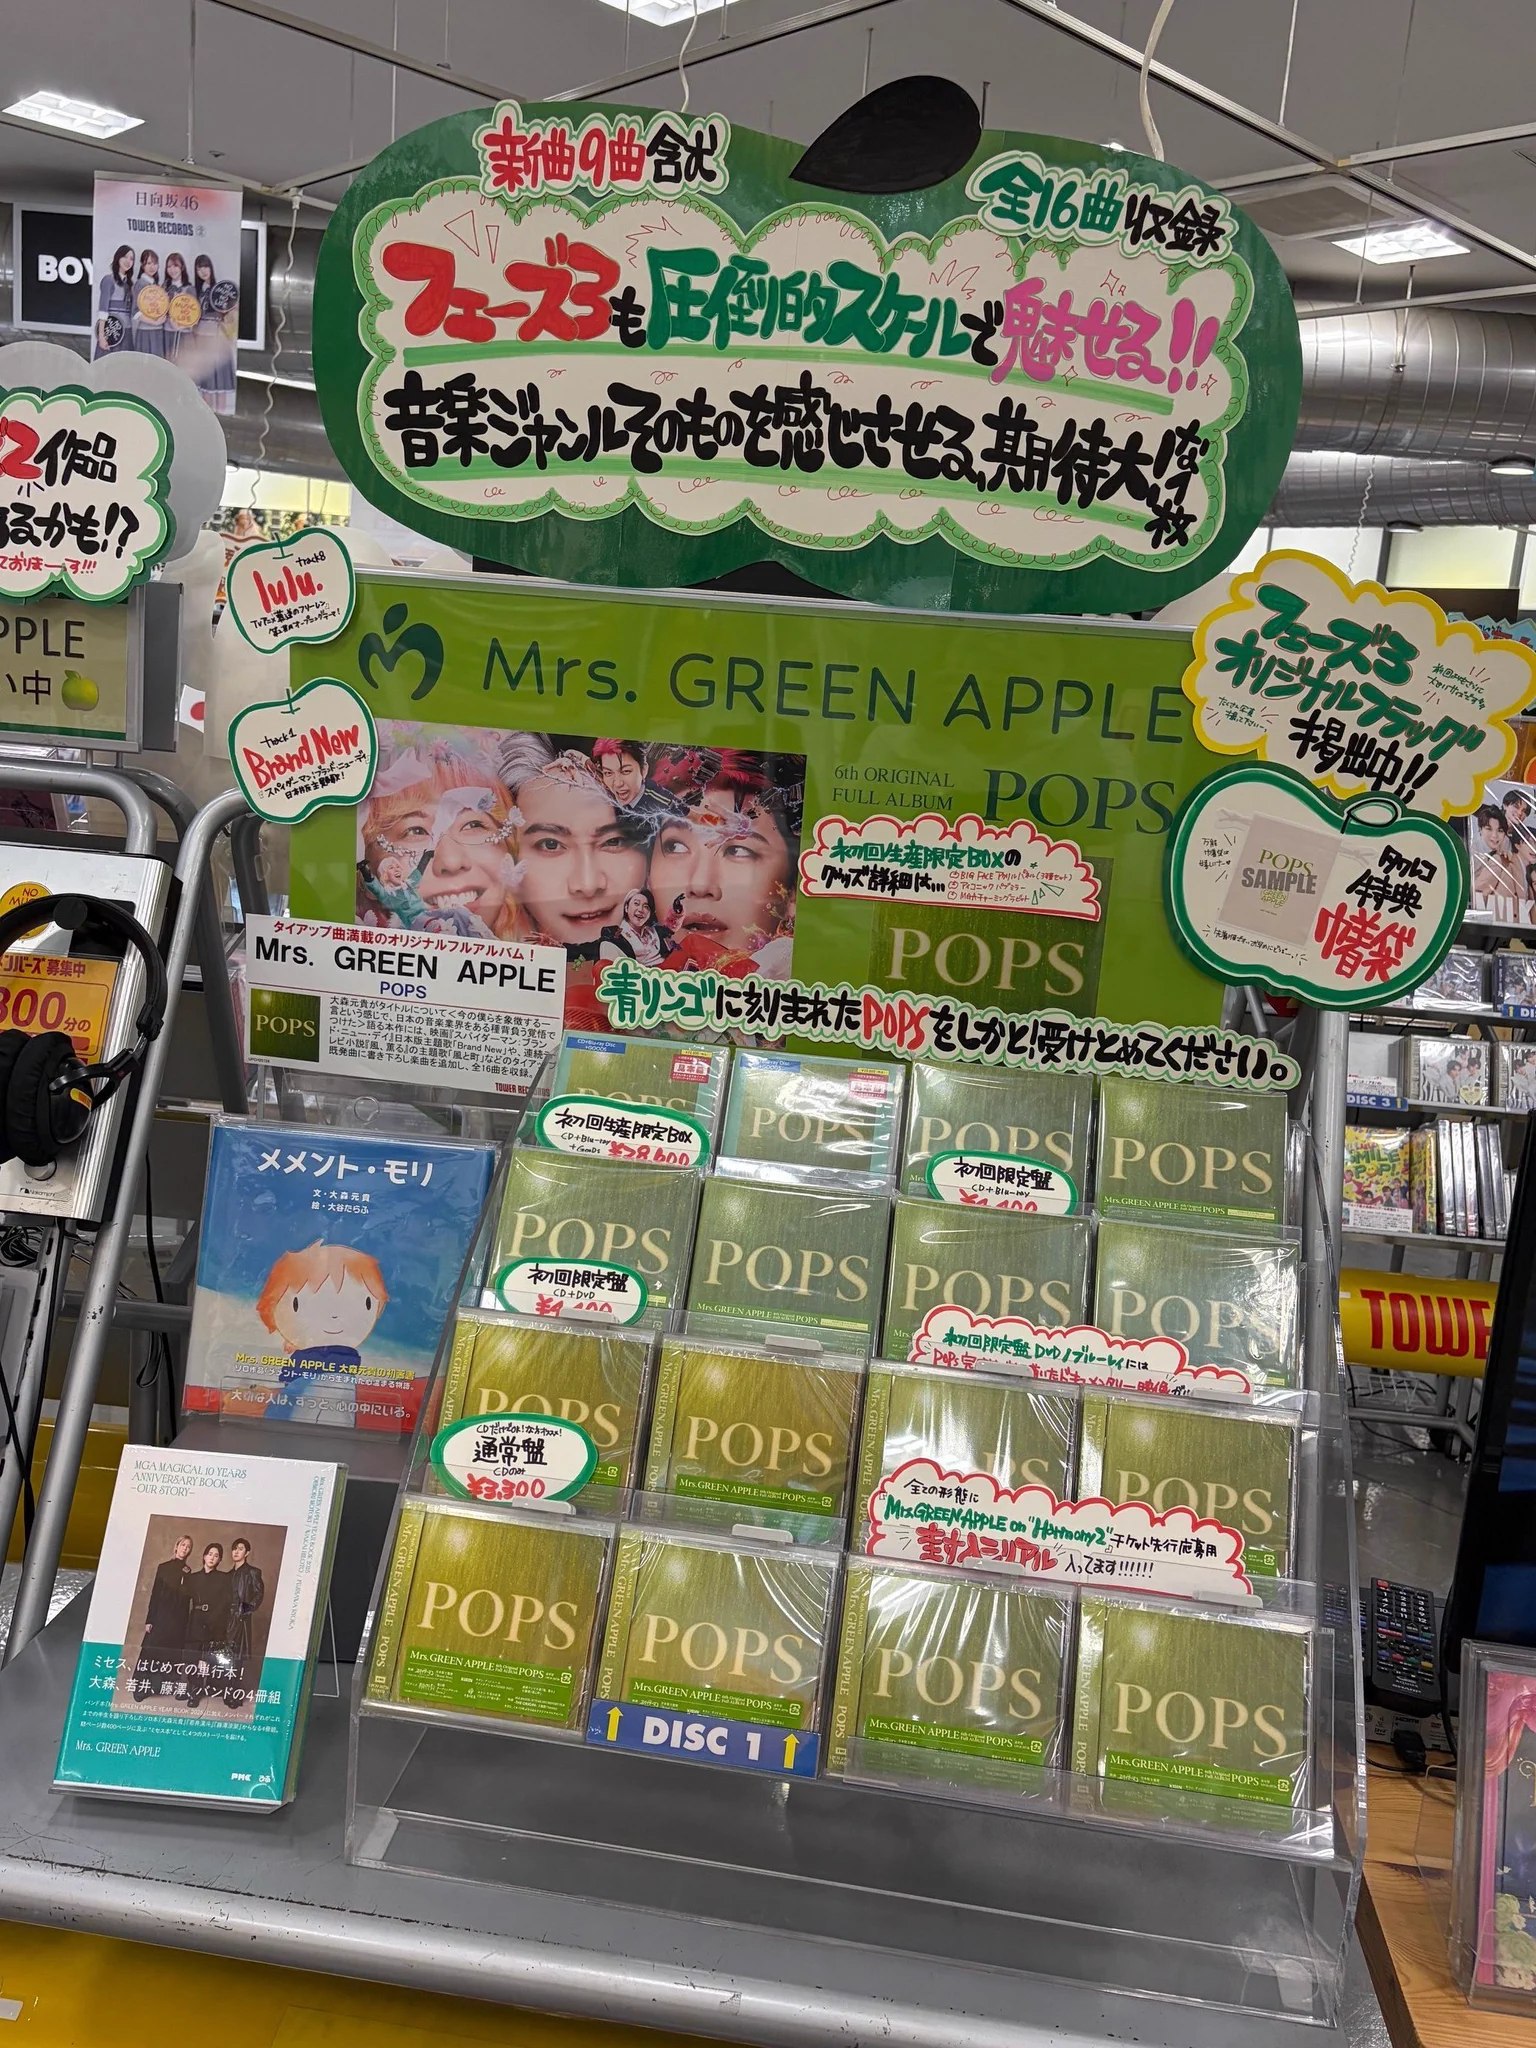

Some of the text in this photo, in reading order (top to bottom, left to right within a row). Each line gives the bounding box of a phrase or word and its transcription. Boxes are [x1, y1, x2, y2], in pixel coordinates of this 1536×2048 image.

[136, 191, 199, 210] 日向坂46
[980, 160, 1225, 253] 全16曲収録
[127, 218, 194, 237] TOWER RECORDS
[296, 551, 327, 567] track8
[253, 566, 323, 614] lulu.
[482, 637, 1184, 744] Mrs. GREEN APPLE
[1215, 630, 1487, 761] オリジナルフラッグ
[260, 728, 297, 749] track1
[243, 725, 359, 789] Brand New
[834, 765, 955, 788] 6th ORIGINAL
[832, 787, 953, 811] FULL ALBUM
[983, 768, 1175, 834] POPS
[960, 871, 975, 881] BIG
[977, 872, 994, 881] FACE
[1258, 848, 1314, 877] POPS
[22, 887, 38, 898] NO
[1241, 867, 1318, 895] SAMPLE
[1346, 869, 1423, 918] 特典
[274, 920, 535, 962] タイアップ曲満載のオリジナルフルアルバム!
[0, 955, 86, 978] ンバーズ募集中
[255, 936, 557, 993] Mrs. GREEN APPLE
[888, 927, 1085, 997] POPS
[379, 981, 427, 999] POPS
[255, 1014, 316, 1038] POPS
[495, 1082, 517, 1094] TOWER
[1346, 1094, 1390, 1107] DISC 3
[555, 1107, 693, 1145] 初回生産限定BOX
[560, 1132, 611, 1146] CD+Blu-ray
[749, 1106, 868, 1146] POPS
[919, 1116, 1075, 1173] POPS
[257, 1148, 434, 1187] メメント・モリ
[953, 1156, 1055, 1191] 初回限定盤
[1109, 1136, 1274, 1195] POPS
[971, 1184, 1031, 1198] CD+Blu-ray
[1151, 1200, 1179, 1211] APPLE
[1203, 1205, 1226, 1215] POPS
[505, 1211, 672, 1274] POPS
[527, 1263, 629, 1293] 初回限定盤
[705, 1239, 869, 1302] POPS
[553, 1288, 595, 1300] CD+DVD
[900, 1264, 1071, 1328] POPS
[746, 1307, 772, 1320] APPLE
[795, 1315, 819, 1325] POPS
[1111, 1288, 1280, 1356] POPS
[235, 1353, 416, 1381] Mrs. GREEN APPLE 大森元貴の初著書
[478, 1387, 621, 1448] POPS
[472, 1436, 548, 1466] 通常盤
[682, 1415, 833, 1477] POPS
[131, 1472, 229, 1489] ANNIVERSARY BOOK
[134, 1460, 247, 1480] MGA MAGICAL 10 YEARS
[730, 1486, 759, 1497] APPLE
[782, 1492, 807, 1504] POPS
[904, 1478, 980, 1504] 全ての形態に
[1116, 1468, 1274, 1535] POPS
[962, 1508, 1008, 1534] APPLE
[1010, 1519, 1026, 1533] on
[417, 1581, 579, 1650] POPS
[639, 1613, 803, 1685] POPS
[94, 1658, 245, 1681] ミセス、はじめての単行本!
[464, 1658, 495, 1672] APPLE
[518, 1667, 545, 1680] POPS
[89, 1676, 281, 1705] 大森、若井、藤澤、バンドの4冊組
[873, 1648, 1042, 1720] POPS
[689, 1690, 721, 1704] APPLE
[746, 1699, 773, 1711] POPS
[1112, 1682, 1287, 1758] POPS
[75, 1740, 161, 1758] Mrs. GREEN APPLE
[643, 1716, 762, 1761] DISC 1
[927, 1727, 960, 1741] APPLE
[986, 1735, 1013, 1748] POPS
[1170, 1764, 1204, 1778] APPLE
[1231, 1773, 1260, 1787] POPS
